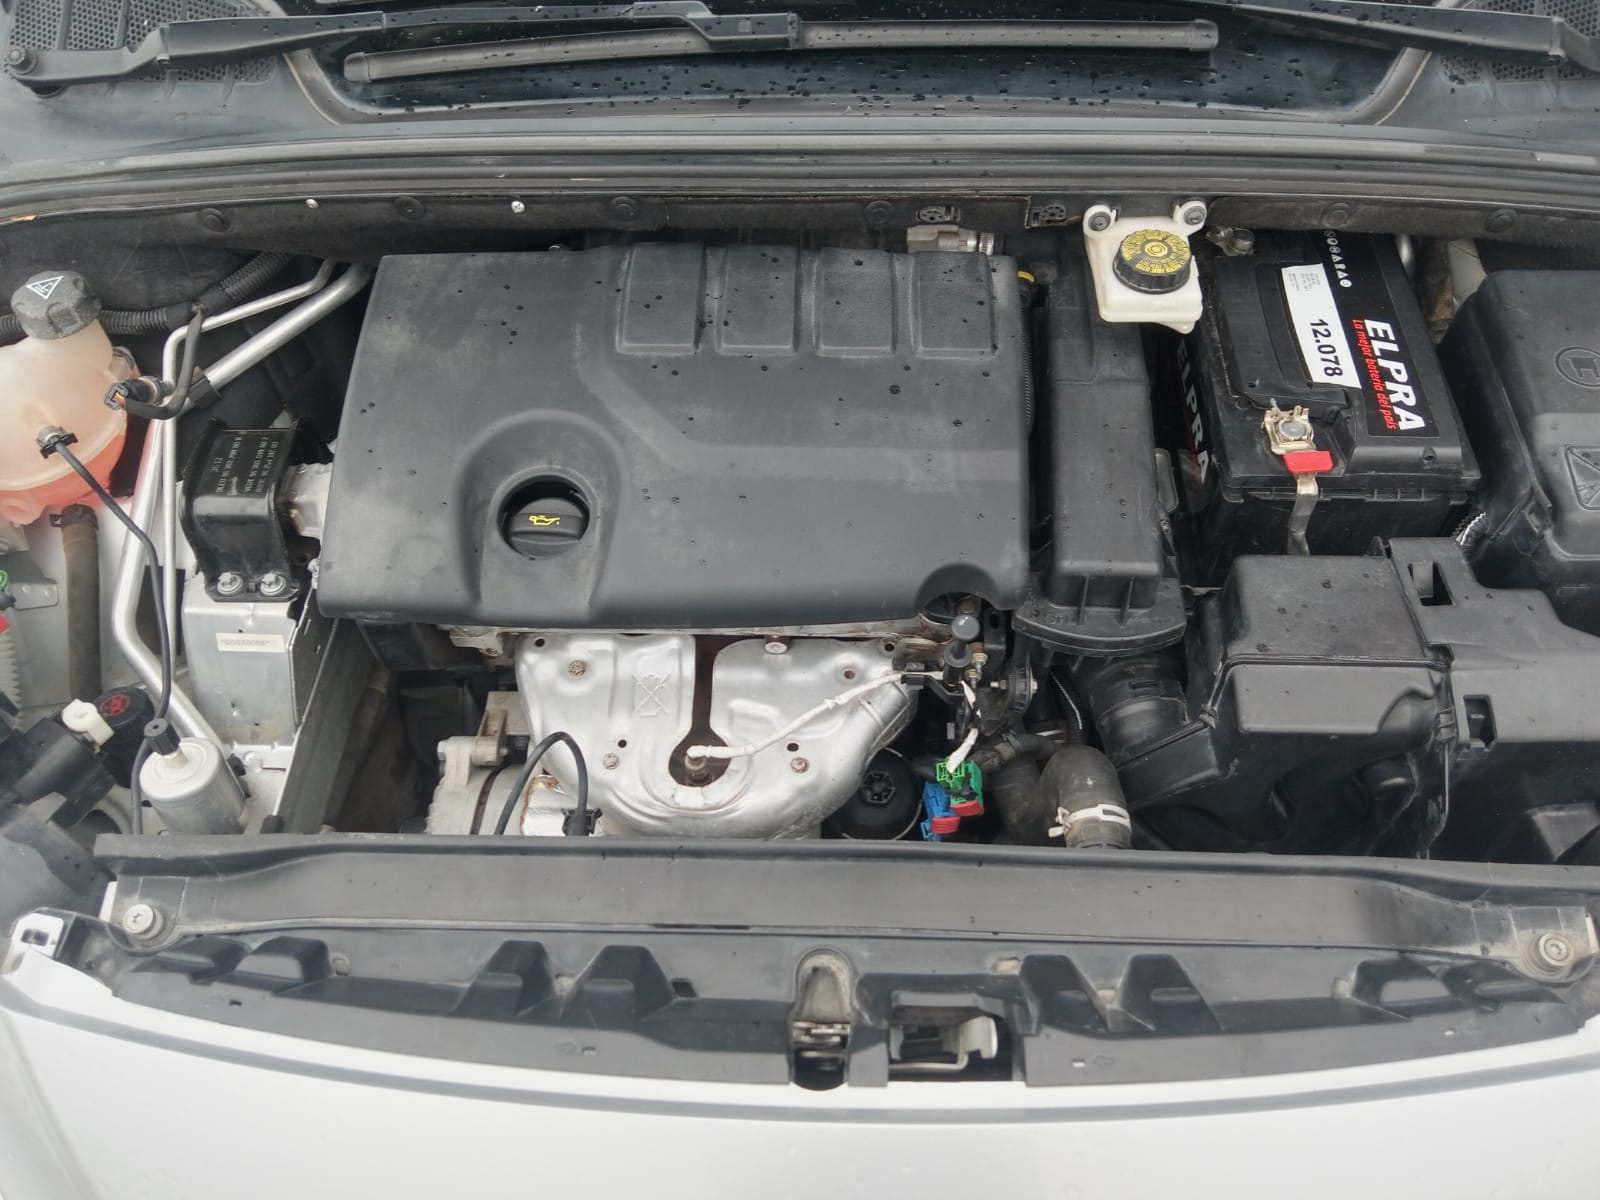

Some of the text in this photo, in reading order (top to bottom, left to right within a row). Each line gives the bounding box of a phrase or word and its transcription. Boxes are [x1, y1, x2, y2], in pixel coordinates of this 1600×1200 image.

[1351, 318, 1364, 329] La
[1356, 331, 1373, 357] mejor
[1310, 318, 1343, 377] 12.078
[1363, 319, 1426, 431] ELPRA
[1176, 338, 1209, 484] ELPRA
[1376, 392, 1393, 408] del
